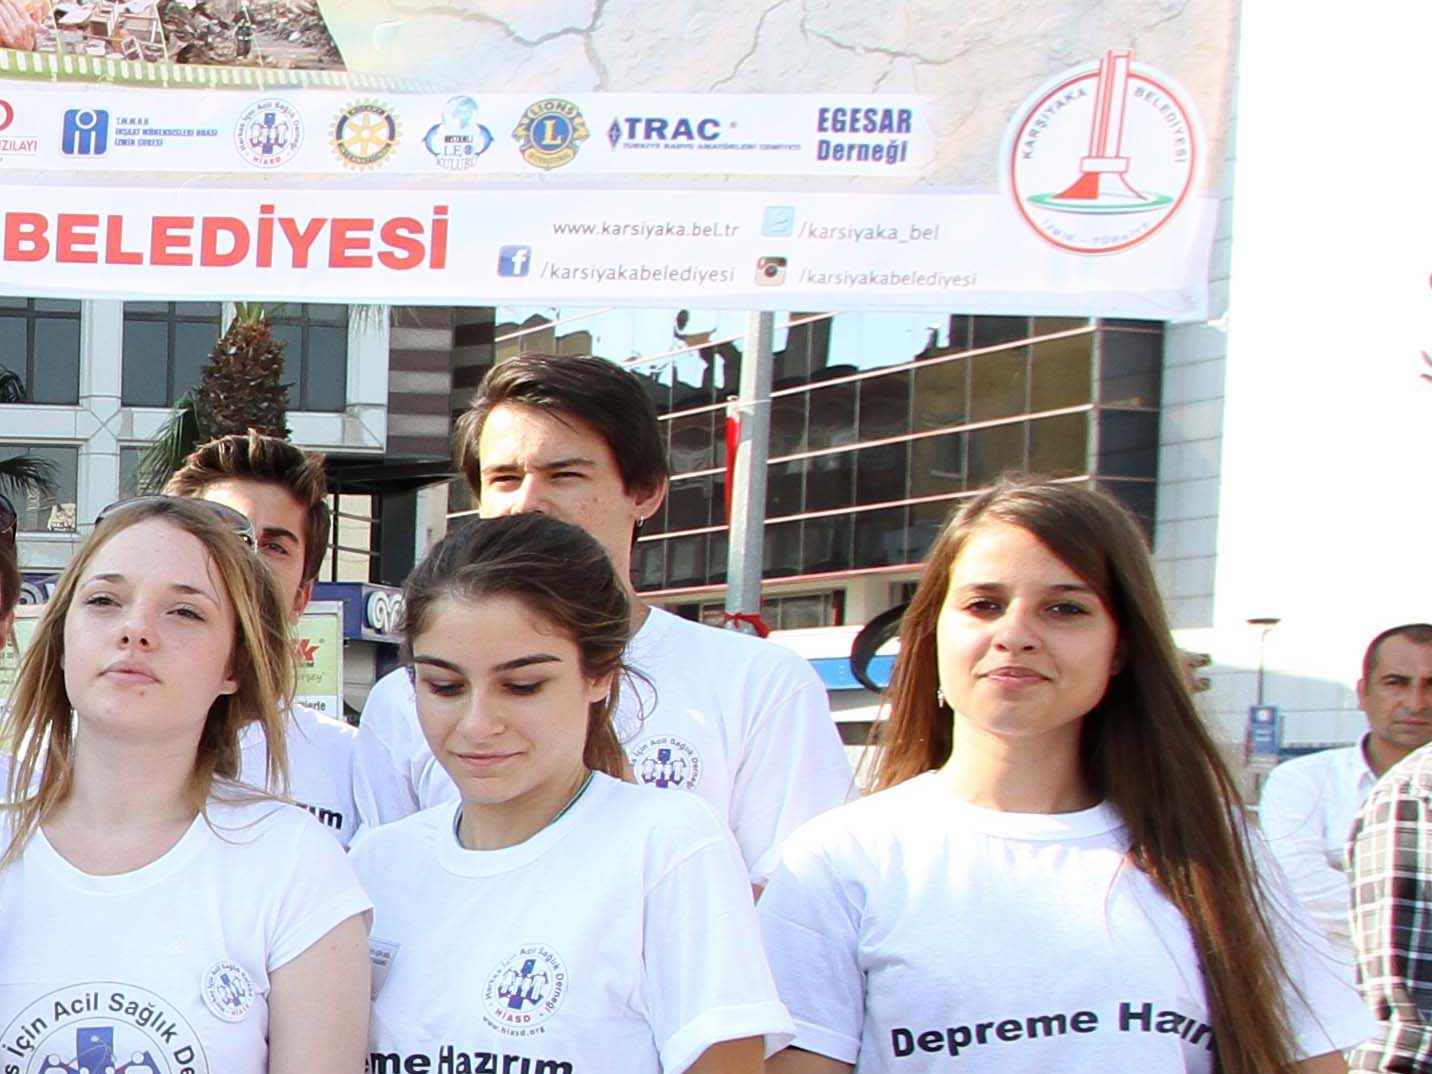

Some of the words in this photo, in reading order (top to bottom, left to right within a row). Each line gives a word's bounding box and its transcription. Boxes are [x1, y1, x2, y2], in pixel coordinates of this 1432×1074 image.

[623, 116, 721, 142] TRAC
[816, 107, 913, 135] EGESAR
[816, 138, 909, 165] Derneği
[2, 203, 448, 271] BELEDİYESİ
[552, 220, 741, 240] www.karsiyaka.bel.tr
[1, 1017, 49, 1058] İçin
[52, 991, 100, 1022] Acil
[107, 992, 178, 1045] Sağlık
[890, 1010, 1099, 1058] Depreme
